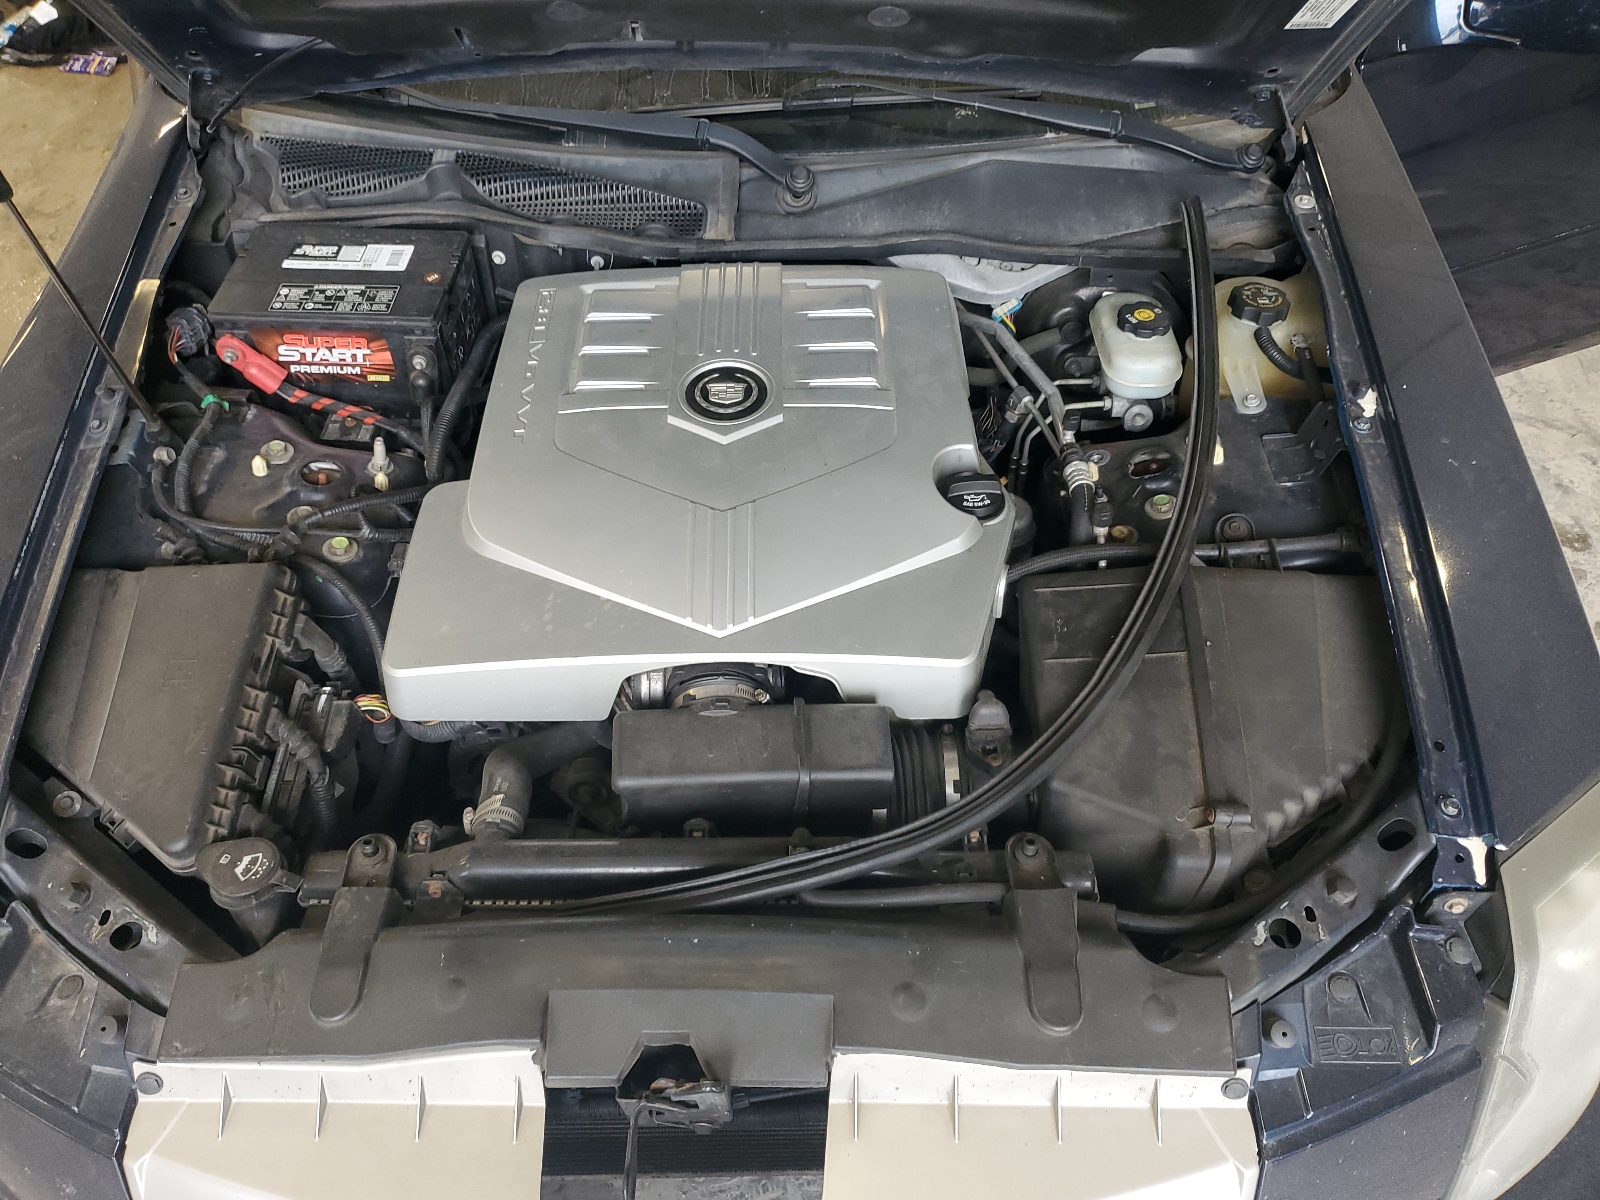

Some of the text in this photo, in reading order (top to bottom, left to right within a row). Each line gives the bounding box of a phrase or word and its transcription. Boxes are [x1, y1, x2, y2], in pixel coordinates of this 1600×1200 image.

[283, 334, 368, 349] SUPER
[278, 345, 371, 363] START
[525, 343, 543, 379] V6
[289, 364, 361, 375] PREMIUM
[513, 383, 535, 443] VVT
